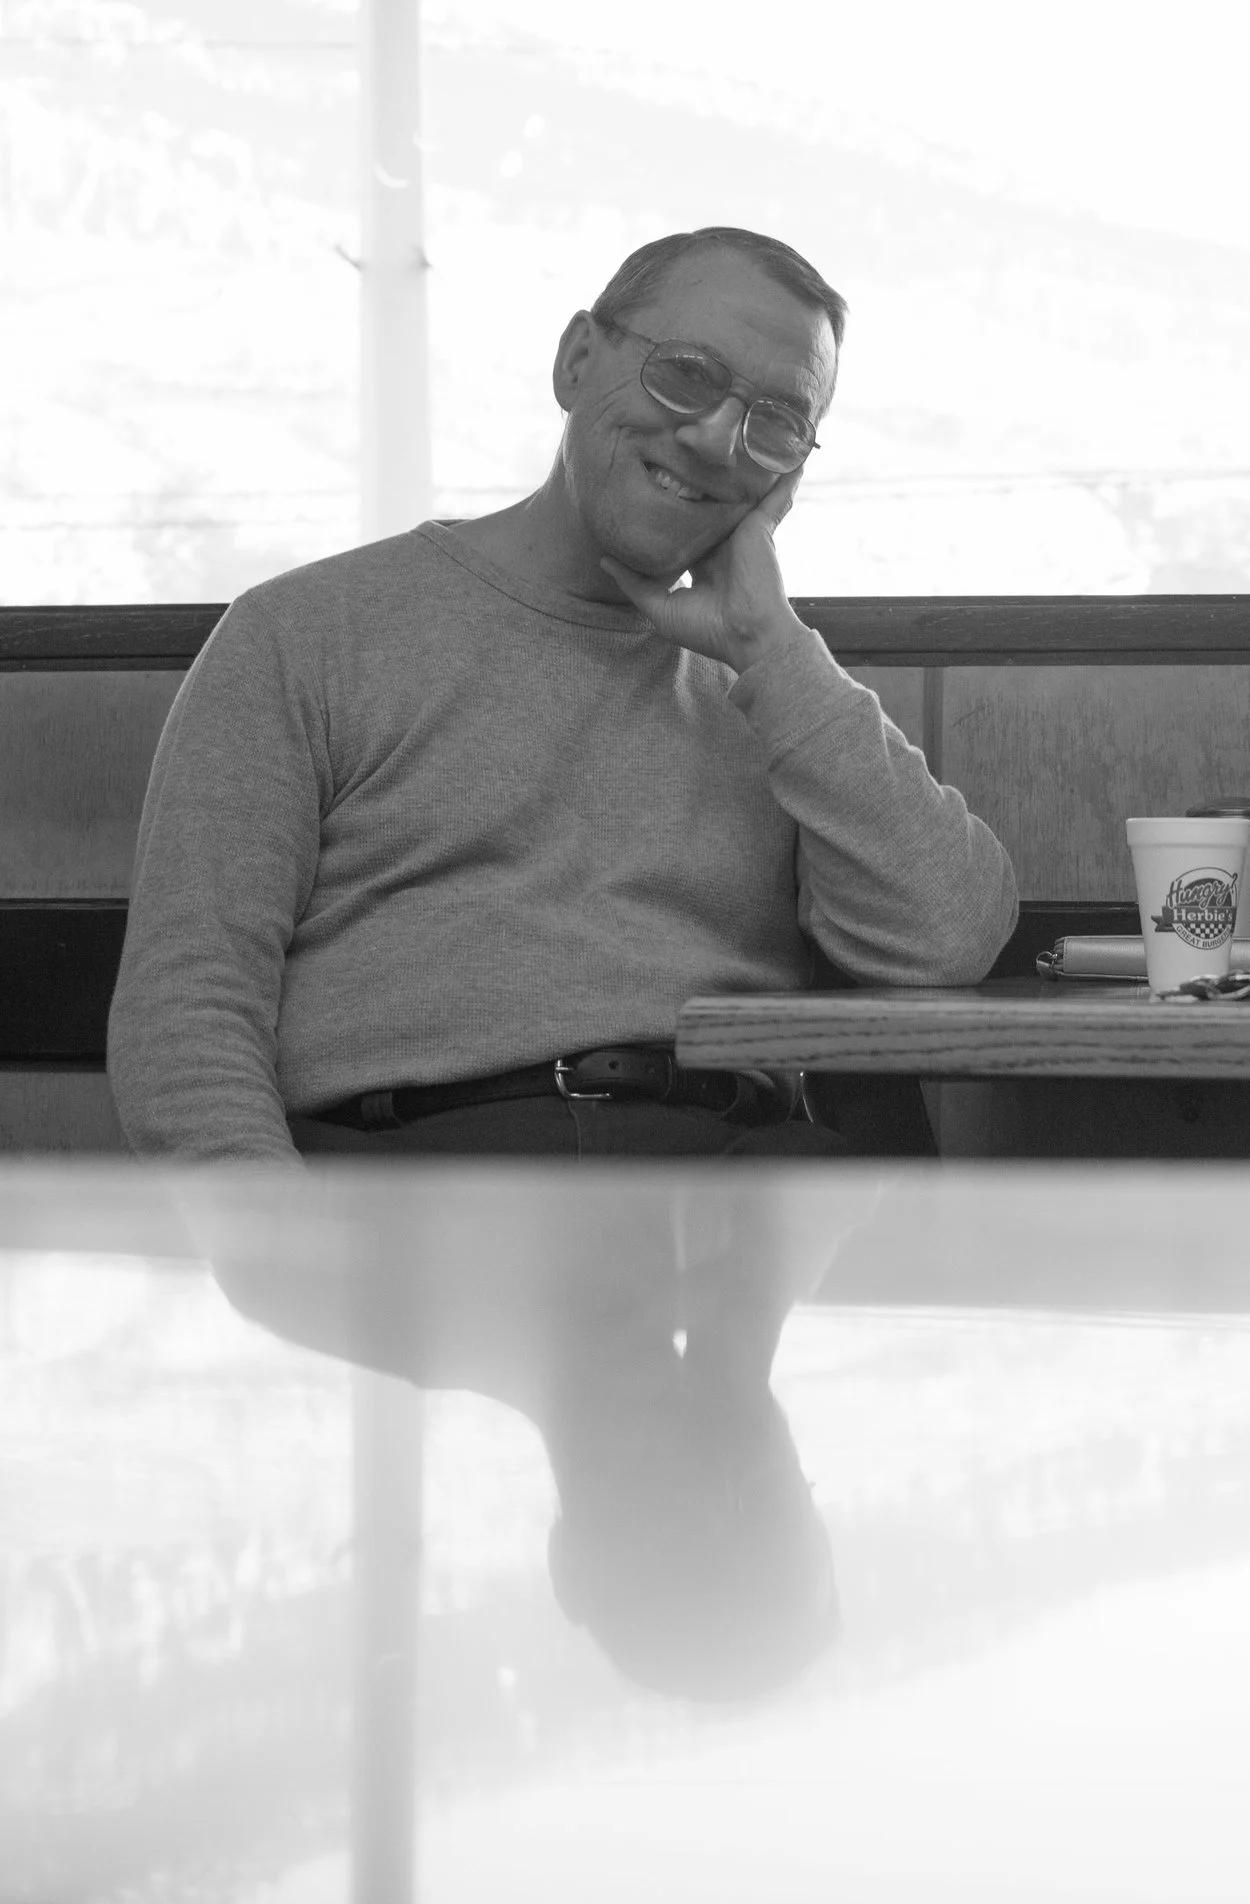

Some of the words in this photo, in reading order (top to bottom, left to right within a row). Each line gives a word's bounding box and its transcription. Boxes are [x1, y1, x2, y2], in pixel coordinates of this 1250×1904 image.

[1166, 872, 1238, 910] Hungry?
[1173, 908, 1233, 922] Herbie's
[1176, 925, 1200, 945] GREAT
